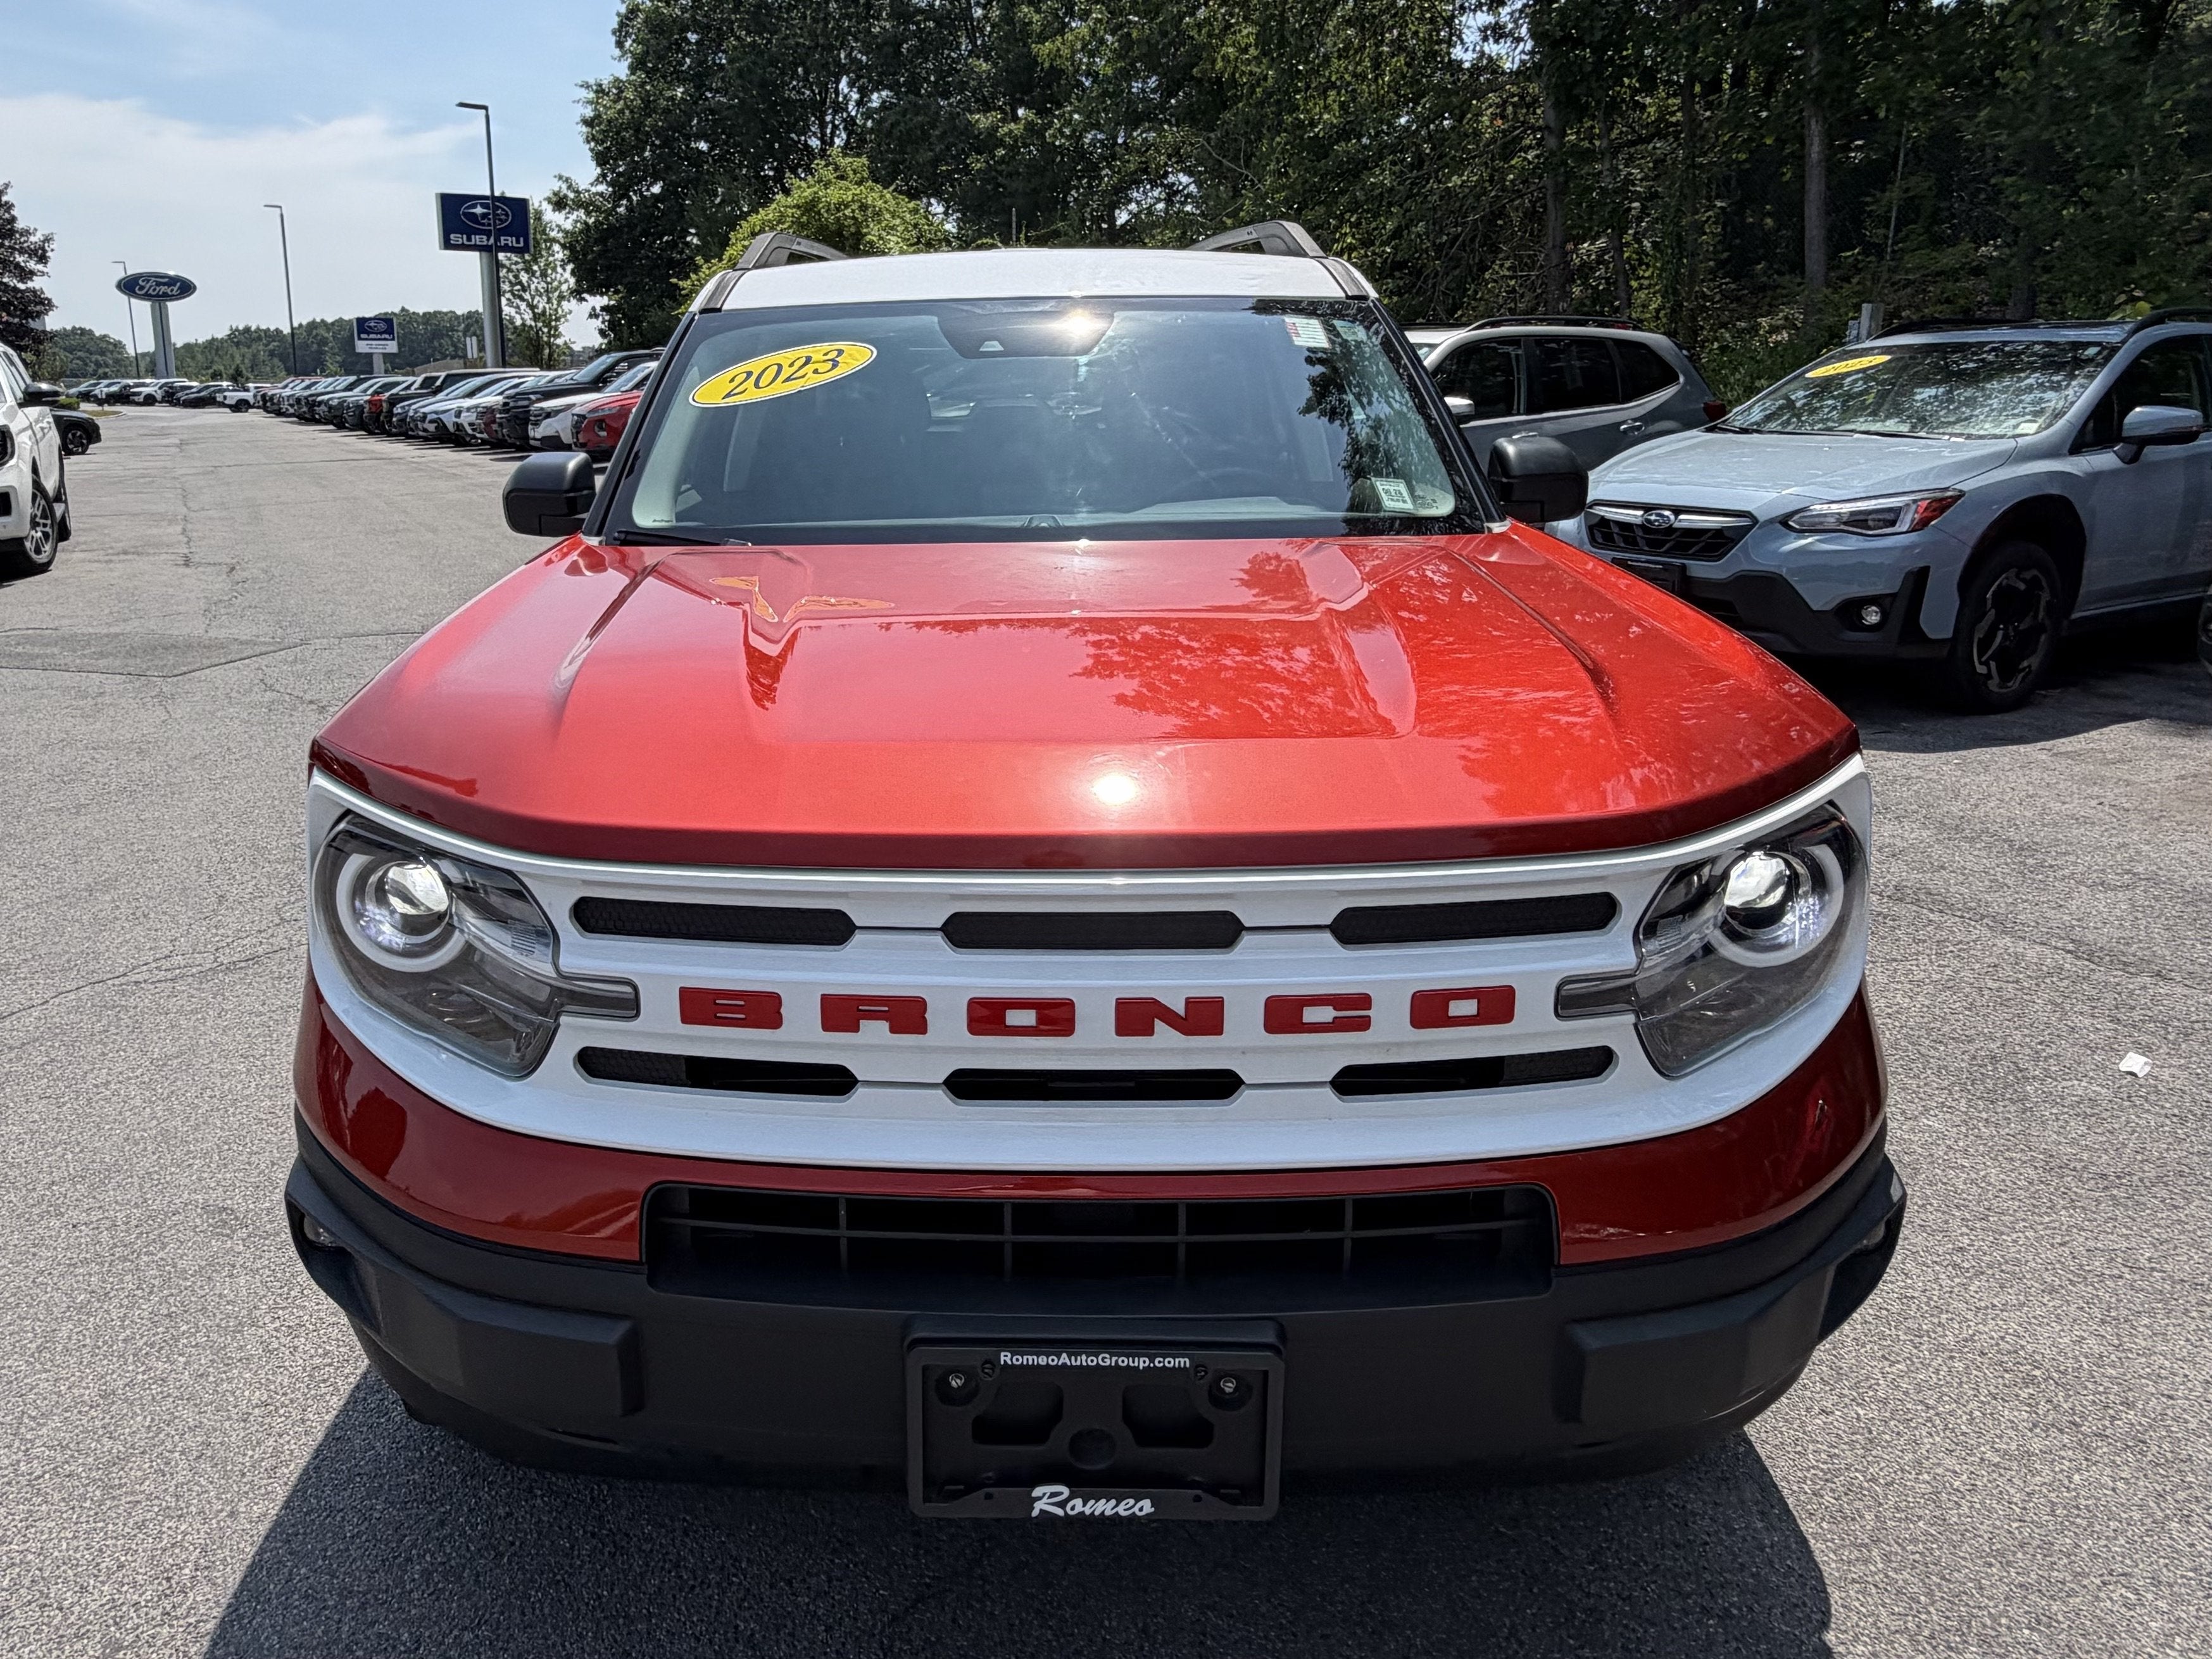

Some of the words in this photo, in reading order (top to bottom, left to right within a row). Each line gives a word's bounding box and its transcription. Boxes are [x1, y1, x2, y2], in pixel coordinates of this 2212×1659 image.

[135, 277, 181, 295] Ford
[721, 348, 845, 400] 2023
[679, 985, 1516, 1038] BRONCO
[1000, 1351, 1190, 1370] RomeoAutoGroup.com
[1031, 1485, 1155, 1517] Romeo
